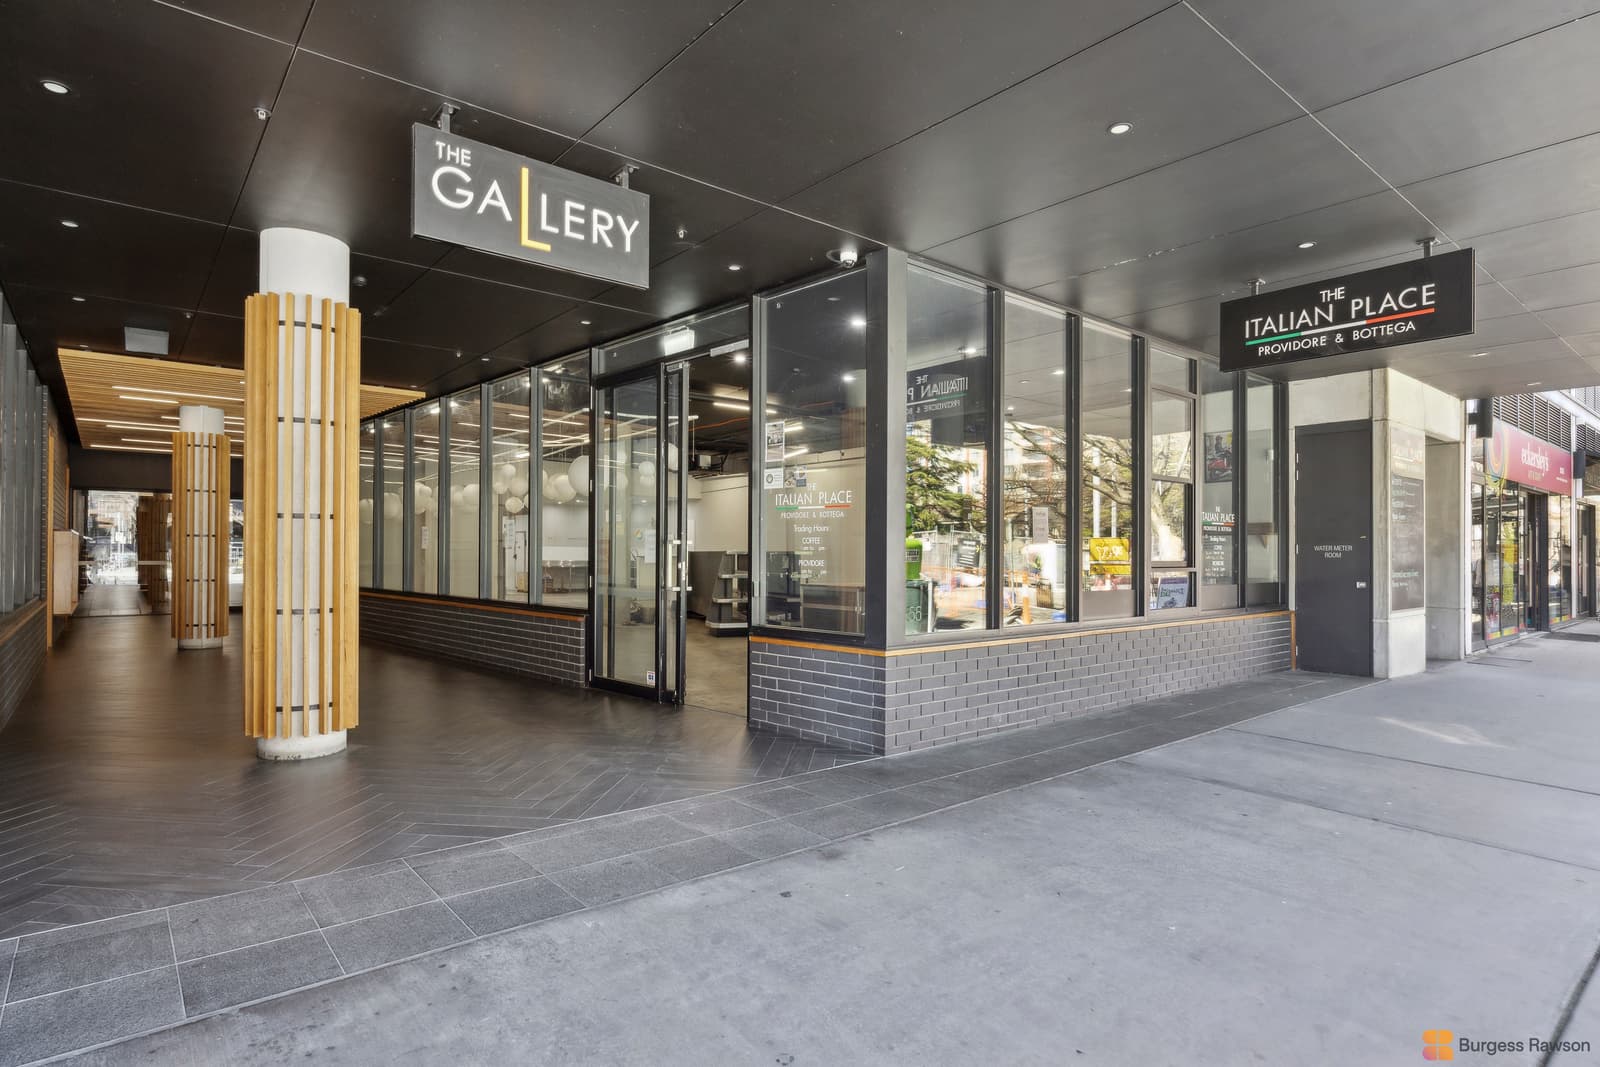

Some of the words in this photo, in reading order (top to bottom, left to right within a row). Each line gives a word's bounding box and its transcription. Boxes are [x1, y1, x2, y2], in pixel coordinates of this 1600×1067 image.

[434, 140, 472, 168] THE
[431, 166, 640, 253] GALLERY
[1319, 286, 1345, 303] THE
[1245, 303, 1334, 339] ITALIAN
[1351, 283, 1436, 319] PLACE
[1258, 335, 1327, 357] PROVIDORE
[1335, 333, 1344, 344] &
[1352, 321, 1416, 341] BOTTEGA
[775, 492, 813, 506] ITALIAN
[818, 490, 853, 504] PLACE
[801, 537, 820, 545] COFFEE
